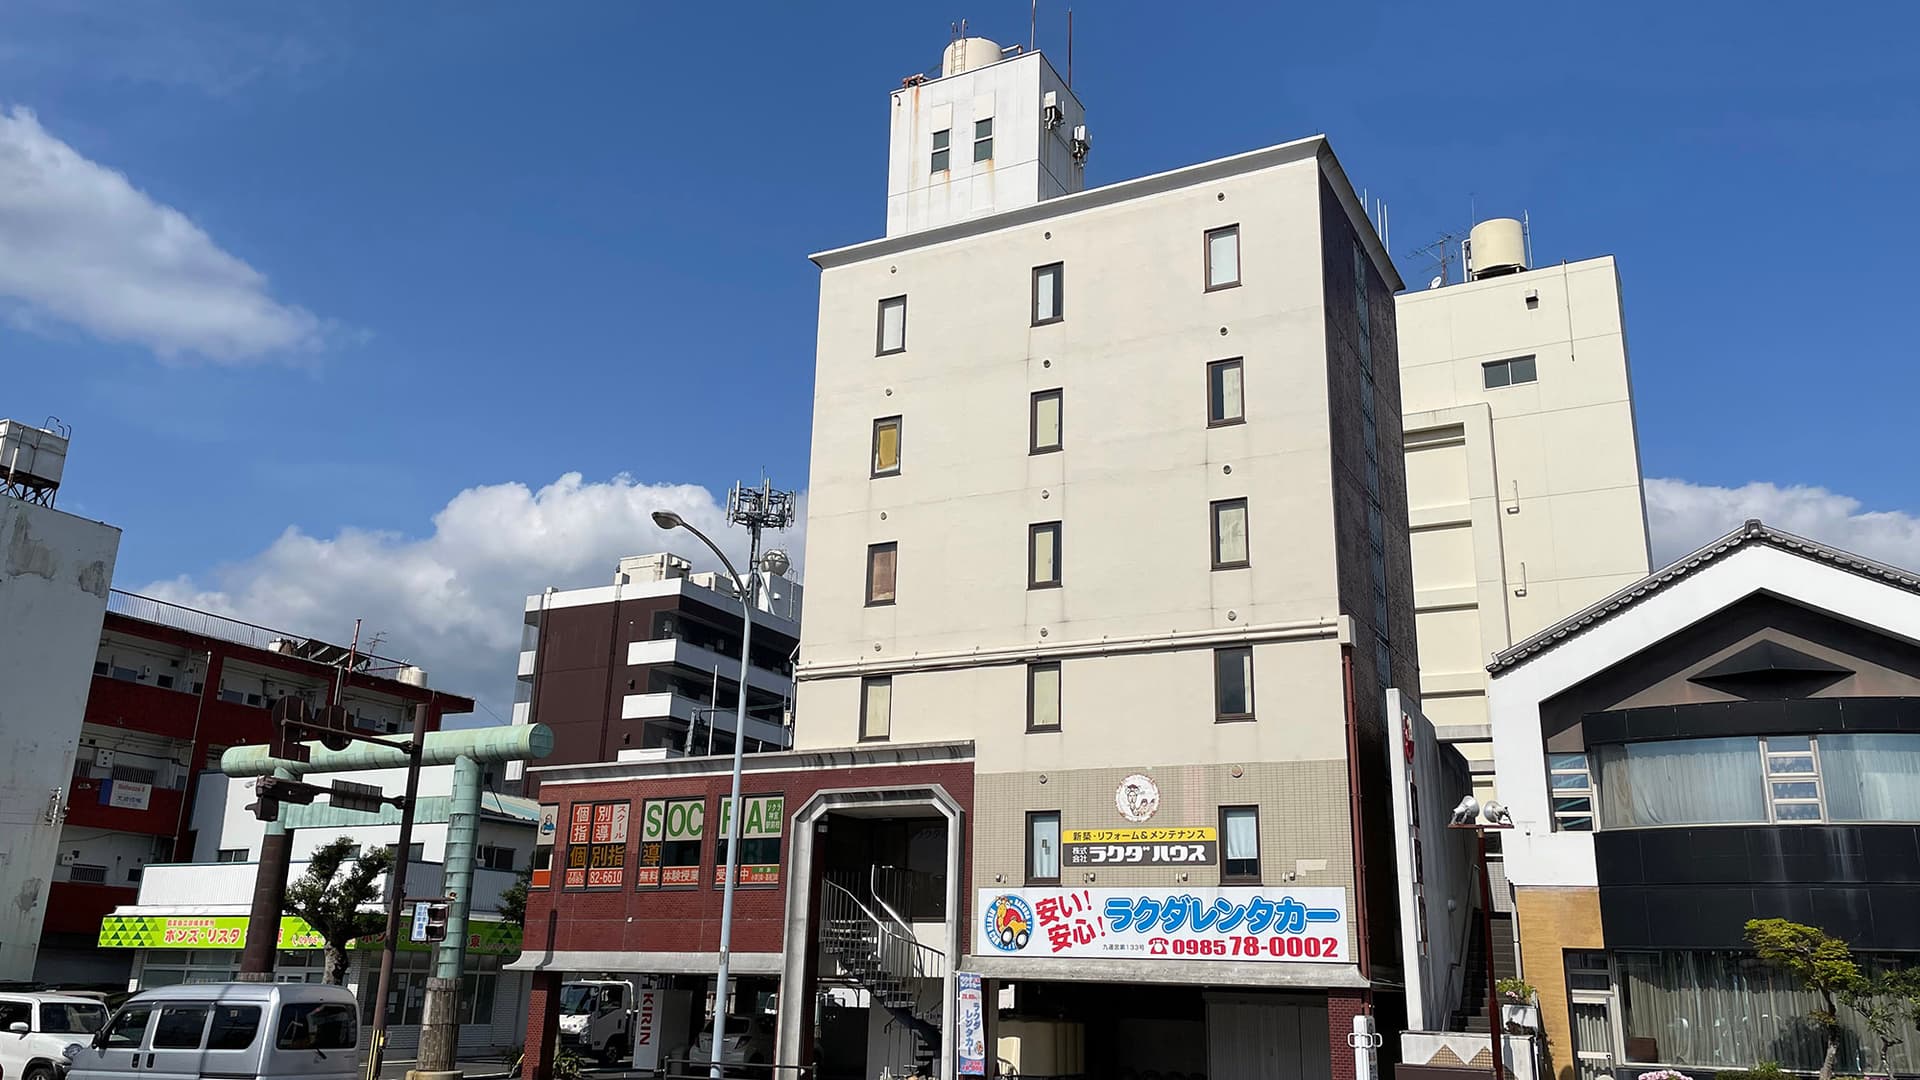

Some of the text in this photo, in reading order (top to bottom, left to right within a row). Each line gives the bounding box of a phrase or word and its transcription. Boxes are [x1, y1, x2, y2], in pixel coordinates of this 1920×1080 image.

[615, 806, 627, 840] スクール
[1089, 844, 1207, 863] ラクダハウス
[589, 870, 623, 884] 82-6610
[1104, 894, 1340, 934] ラクダレンタカー
[639, 993, 654, 1046] KIRIN
[964, 1009, 974, 1056] レンタカー
[973, 1002, 981, 1030] ラクダ
